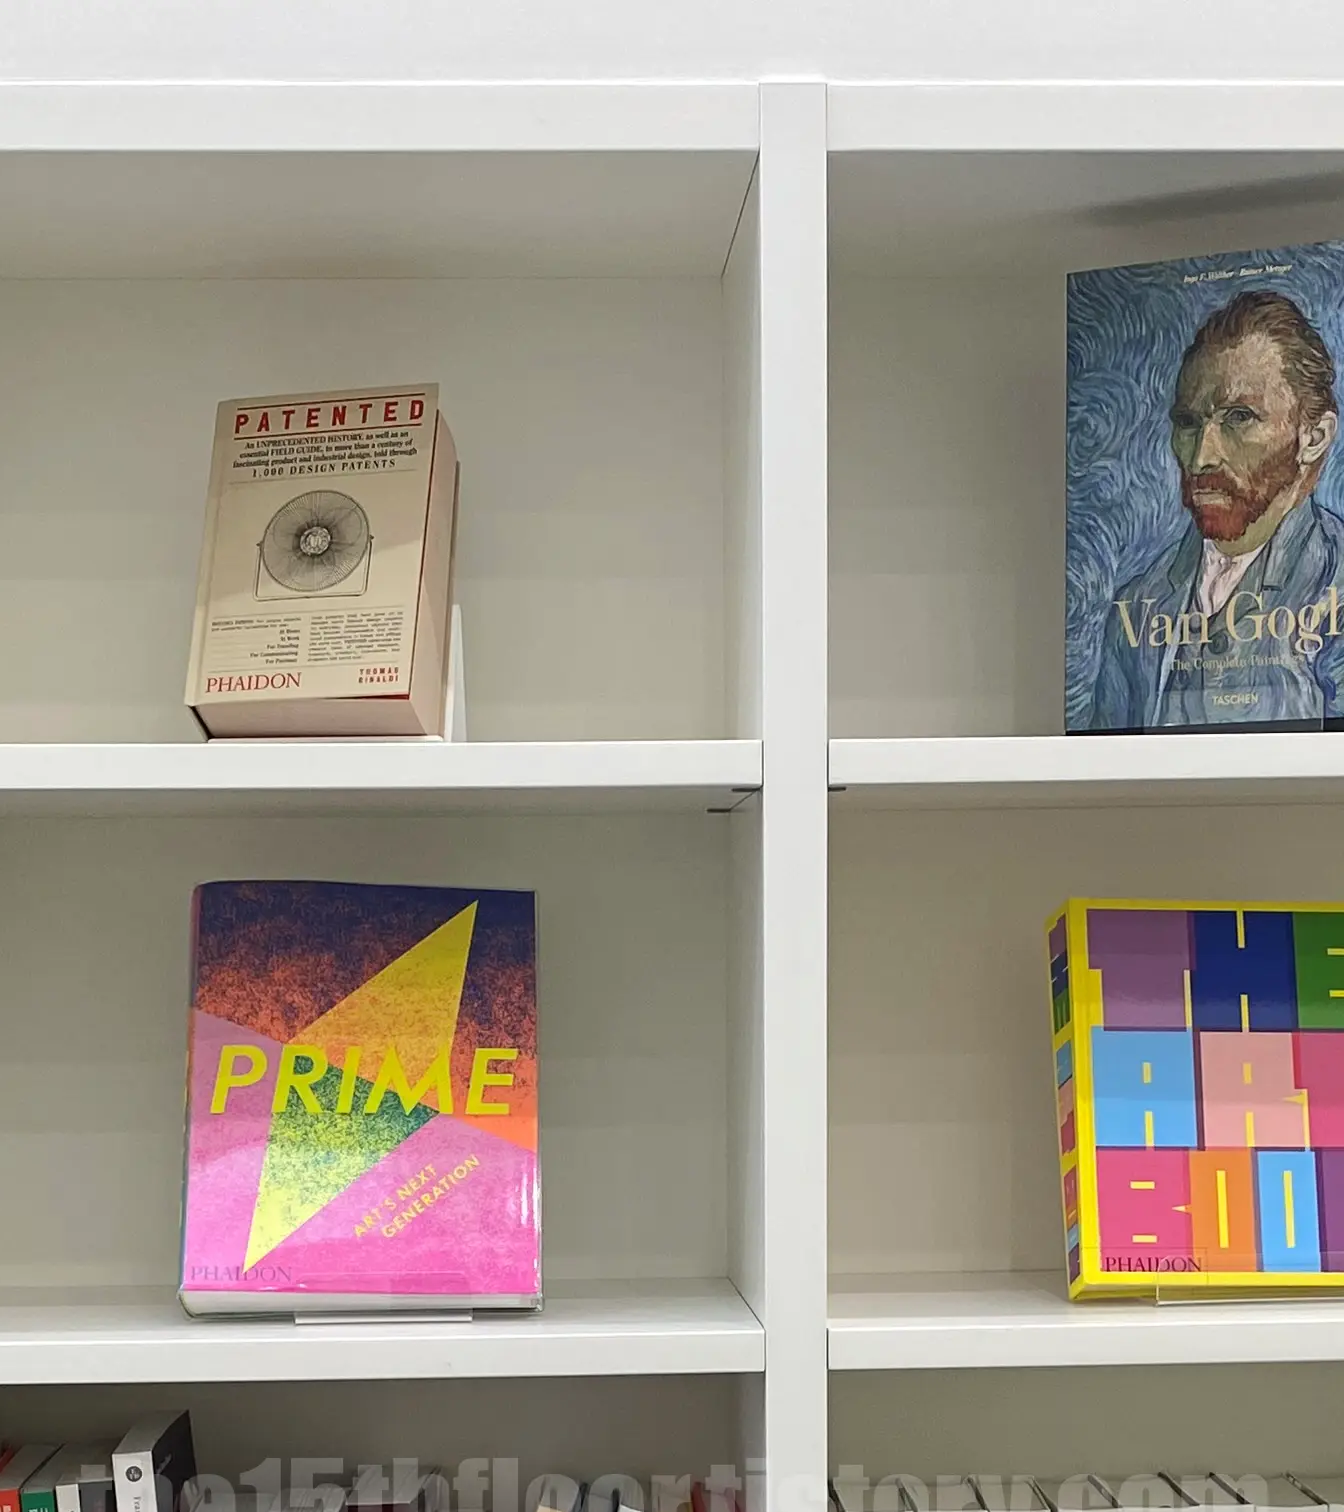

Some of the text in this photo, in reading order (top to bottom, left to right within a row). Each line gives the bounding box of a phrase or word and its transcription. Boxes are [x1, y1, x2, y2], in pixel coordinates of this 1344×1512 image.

[234, 400, 424, 434] PATENTED
[271, 446, 295, 456] FIELD
[290, 459, 396, 475] DESIGN PATENTS
[1113, 598, 1209, 649] Van
[205, 672, 302, 693] PHAIDON
[1212, 693, 1259, 707] TASCHEN
[210, 1044, 519, 1115] PRIME
[353, 1162, 437, 1238] ART'S NEXT
[382, 1154, 481, 1239] GENERATION
[190, 1265, 292, 1282] PHAIDON
[1105, 1256, 1203, 1273] PHAIDON
